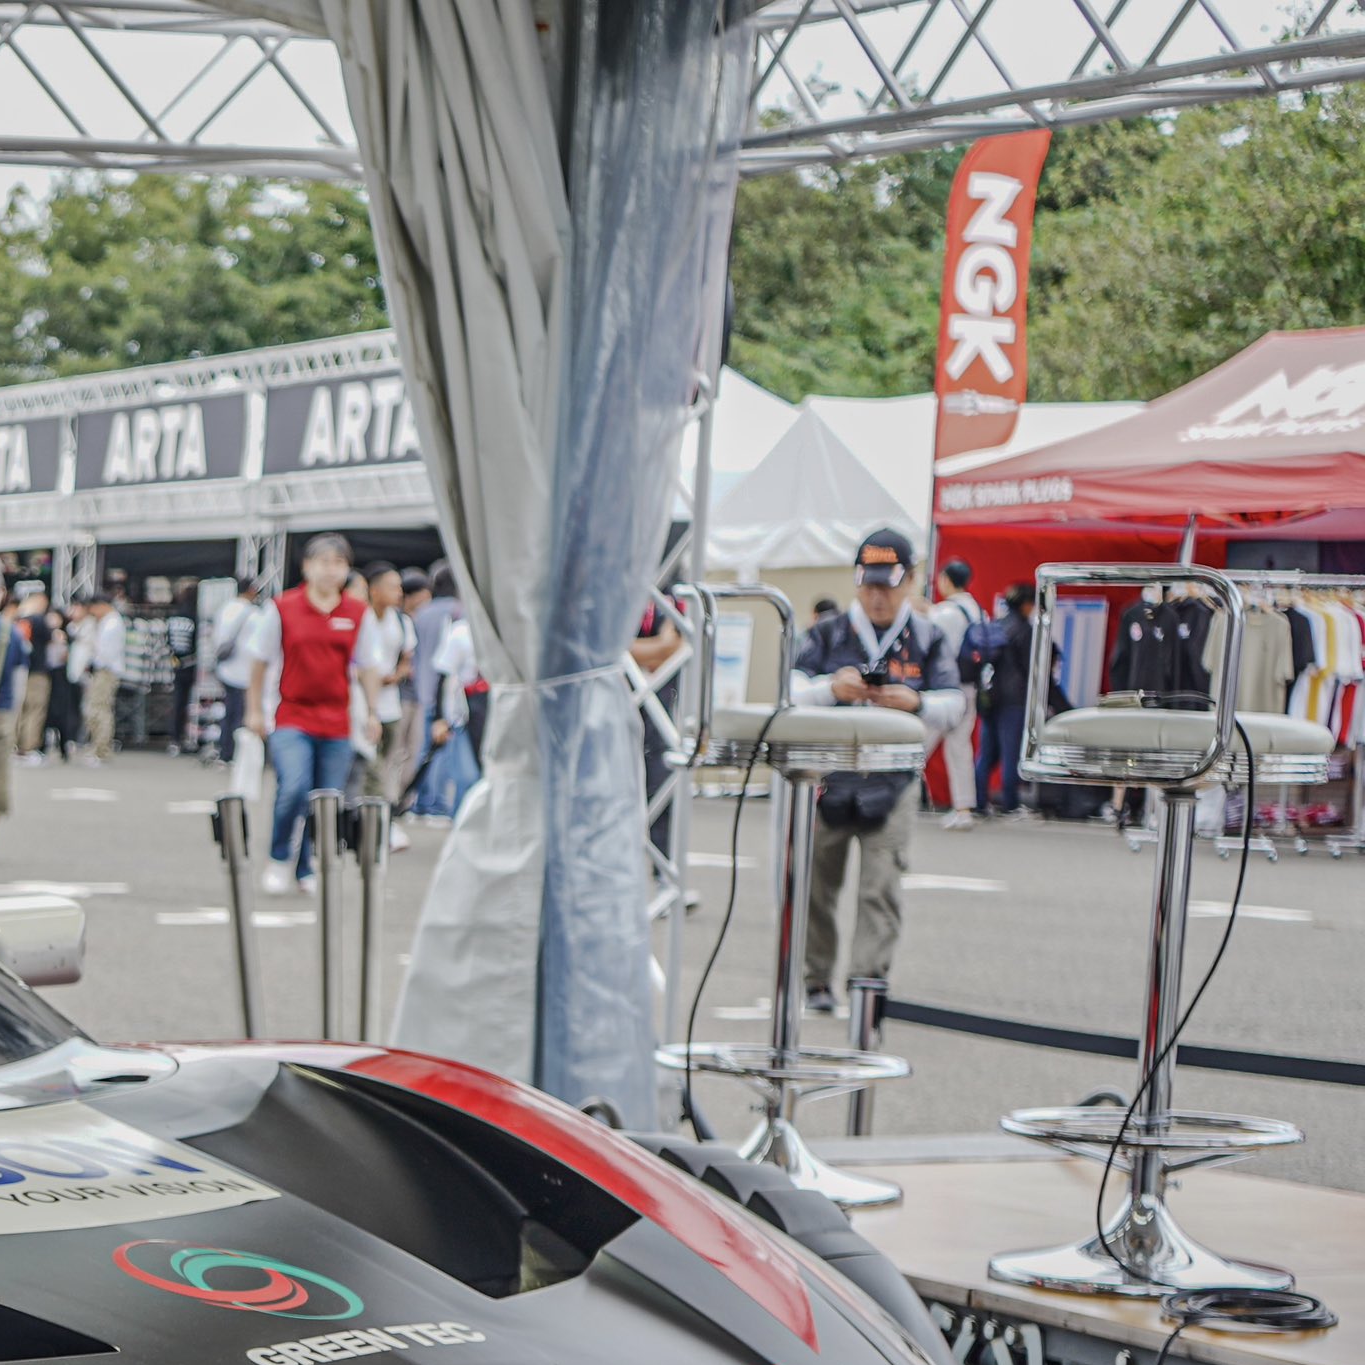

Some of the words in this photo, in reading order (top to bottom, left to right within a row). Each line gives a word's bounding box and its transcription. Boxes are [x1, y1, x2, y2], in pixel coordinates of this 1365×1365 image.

[944, 170, 1025, 385] NGK
[101, 400, 207, 485] ARTA
[299, 376, 420, 467] ARTA
[3, 1183, 103, 1207] YOUR
[105, 1176, 251, 1202] VISION
[395, 1319, 486, 1352] TEC
